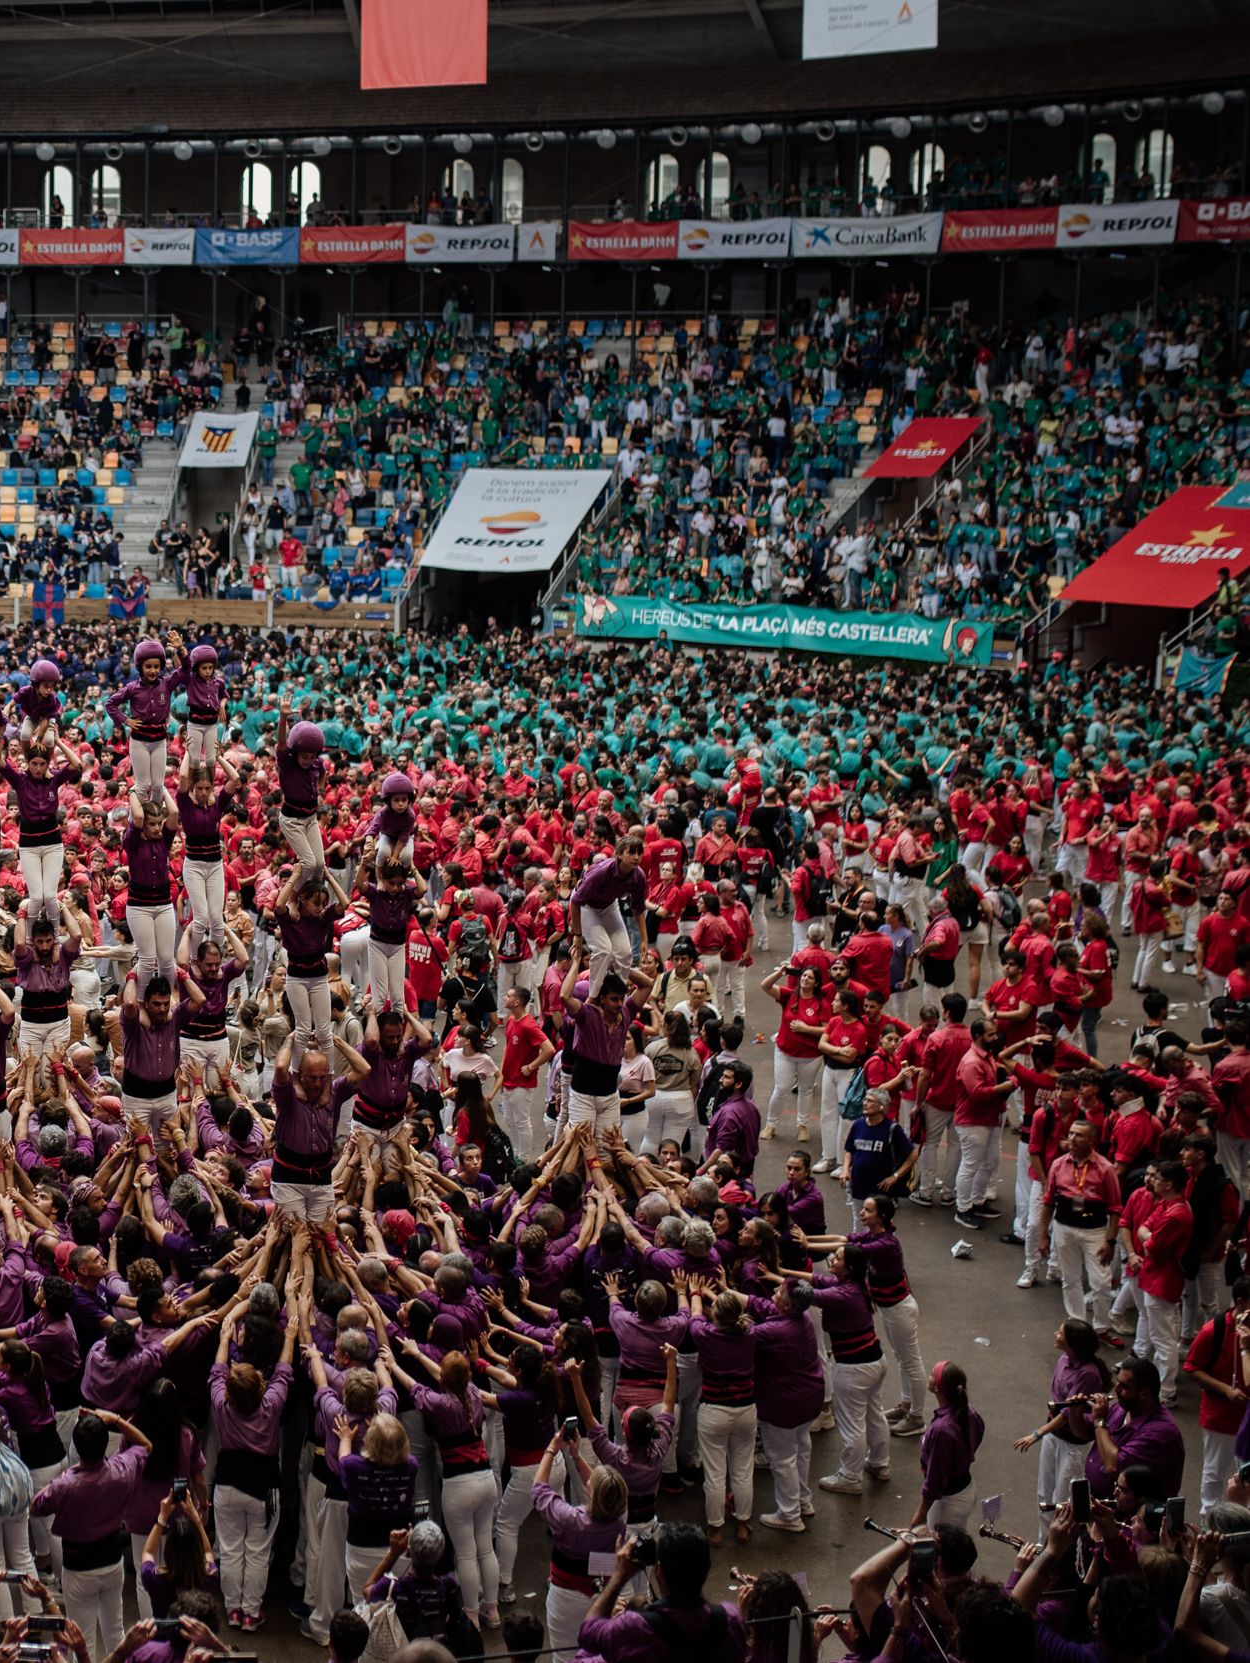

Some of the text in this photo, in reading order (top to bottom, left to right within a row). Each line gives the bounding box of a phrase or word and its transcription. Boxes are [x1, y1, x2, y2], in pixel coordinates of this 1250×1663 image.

[1103, 216, 1174, 231] REPSOL
[835, 225, 927, 246] CaixaBank
[961, 223, 1055, 240] ESTRELLA DAMM
[236, 231, 283, 247] BASF
[447, 238, 511, 249] REPSOL
[586, 236, 676, 249] ESTRELLA DAMM
[721, 232, 787, 245] REPSOL
[37, 241, 88, 254] ESTRELLA
[151, 241, 191, 251] REPSOL
[317, 239, 404, 252] ESTRELLA DAMM
[490, 478, 580, 488] Donem suport
[496, 495, 542, 503] cultura
[454, 537, 547, 548] REPSOL
[1134, 542, 1243, 560] ESTRELLA
[632, 607, 691, 628] HEREUS
[693, 613, 711, 629] DE
[742, 615, 789, 638] PLAÇA
[792, 615, 827, 638] MÉS
